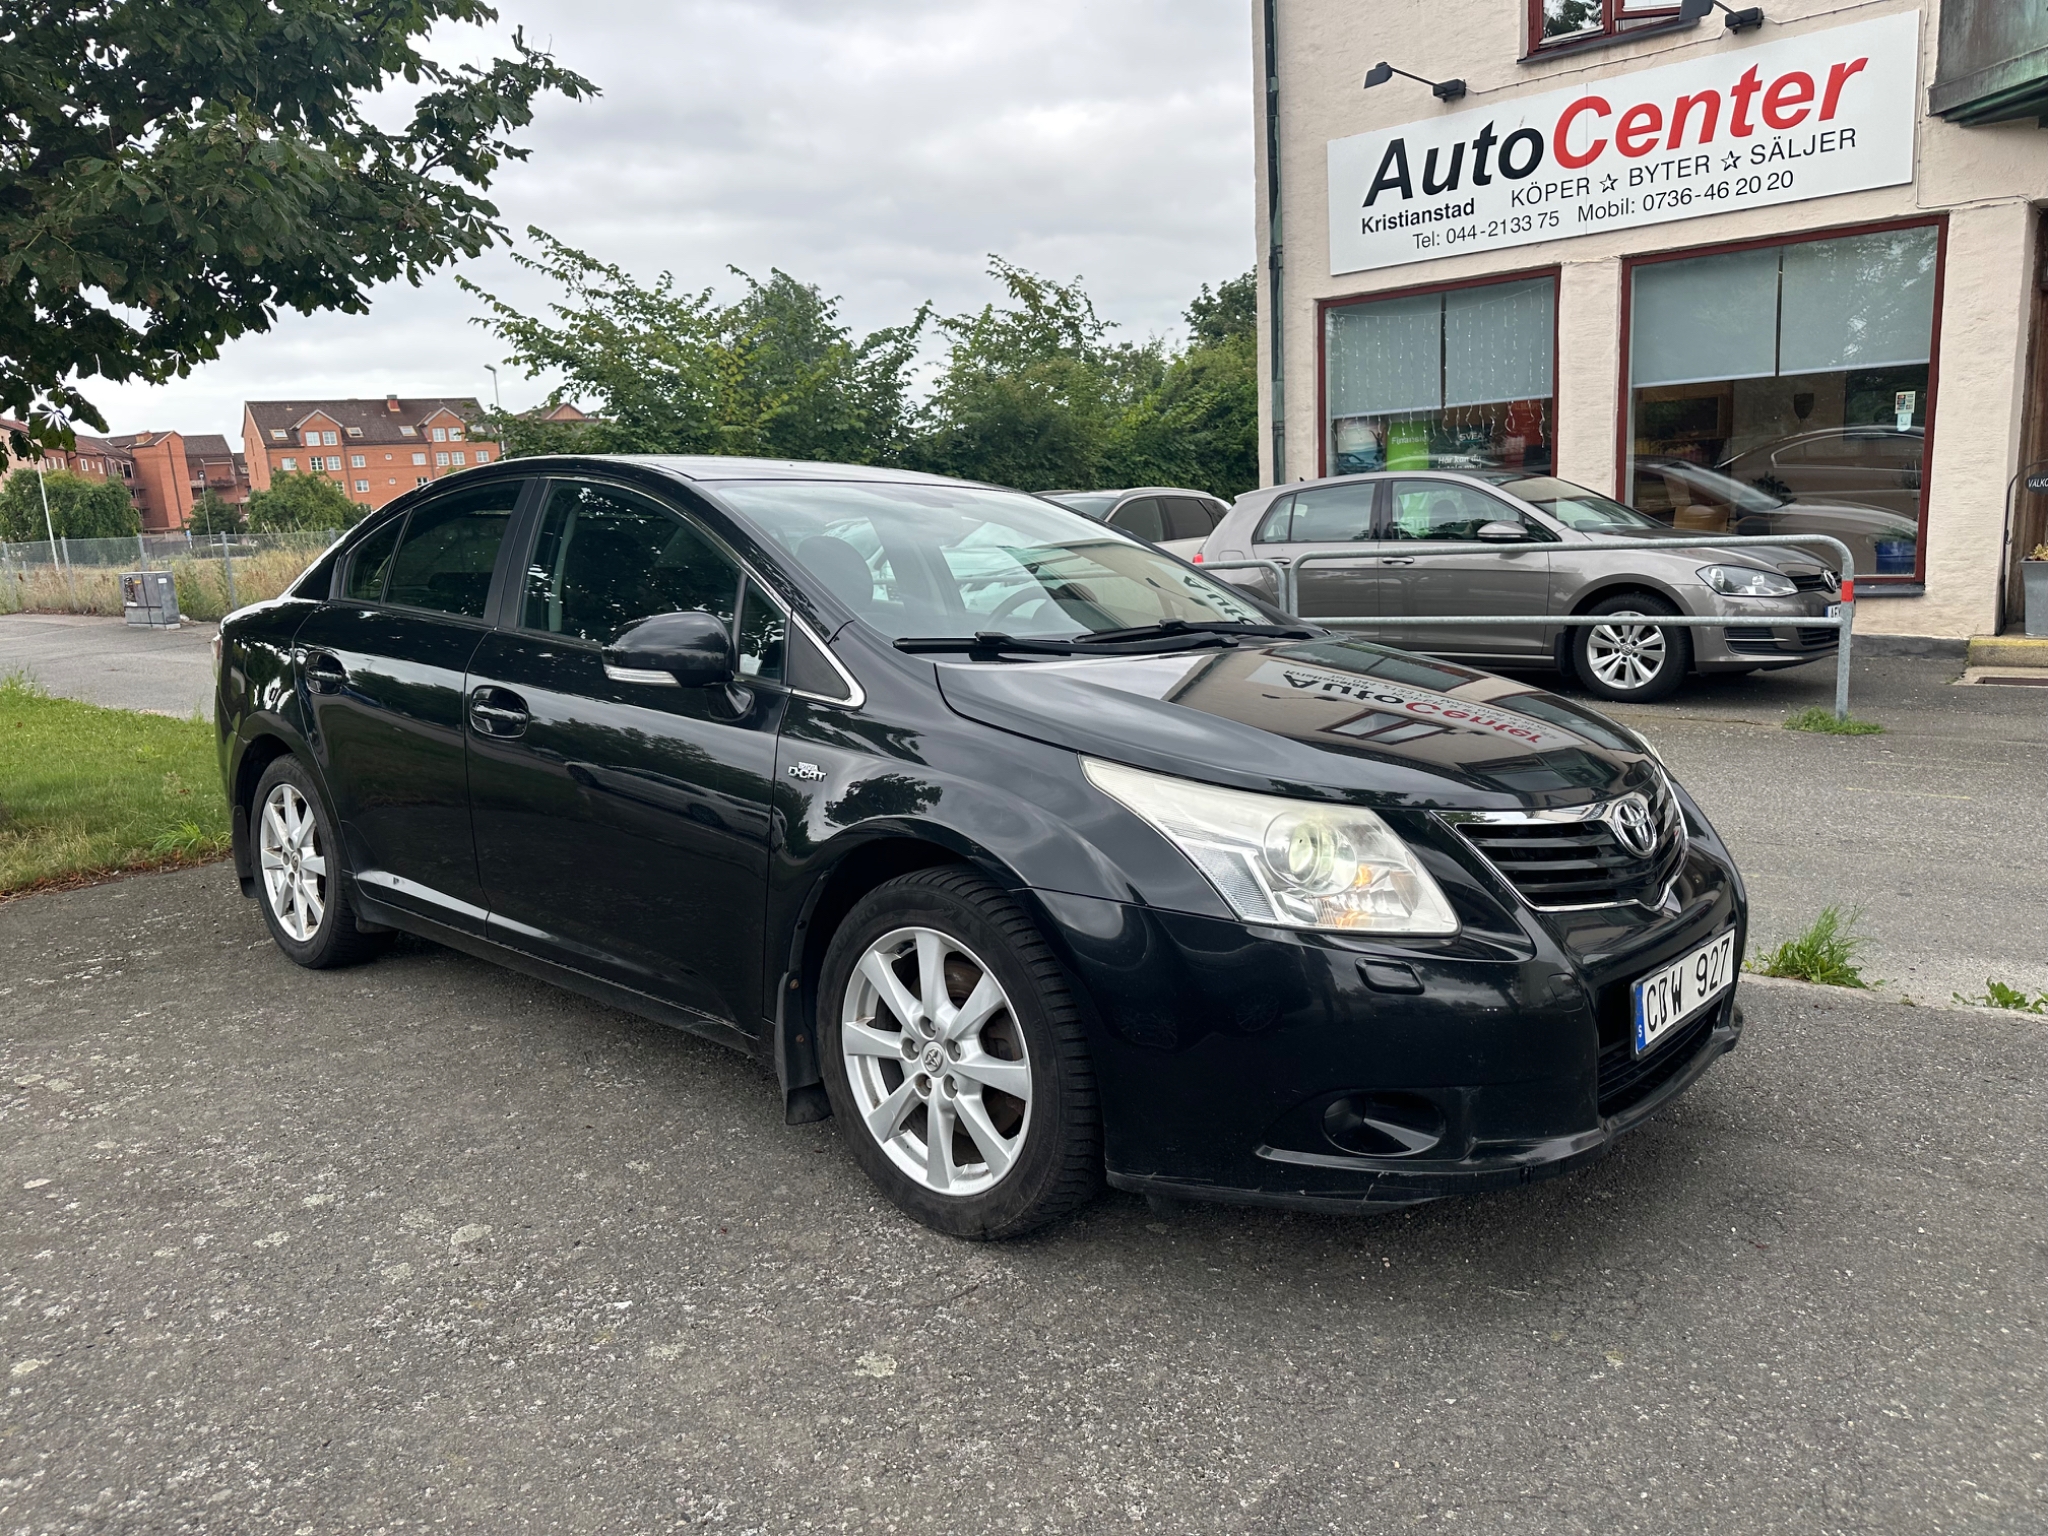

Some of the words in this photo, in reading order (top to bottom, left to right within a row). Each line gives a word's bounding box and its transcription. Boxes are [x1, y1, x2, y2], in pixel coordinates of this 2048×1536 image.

[1511, 177, 1590, 207] KÖPER
[1629, 154, 1710, 187] BYTER
[1750, 128, 1856, 165] SÄLJER
[1362, 198, 1475, 234] Kristianstad
[1413, 231, 1440, 249] Tel:
[1538, 210, 1559, 229] 75
[1578, 197, 1635, 222] Mobil:
[1459, 432, 1484, 441] SVEA
[1696, 938, 1730, 997] 927
[1638, 1024, 1643, 1038] S
